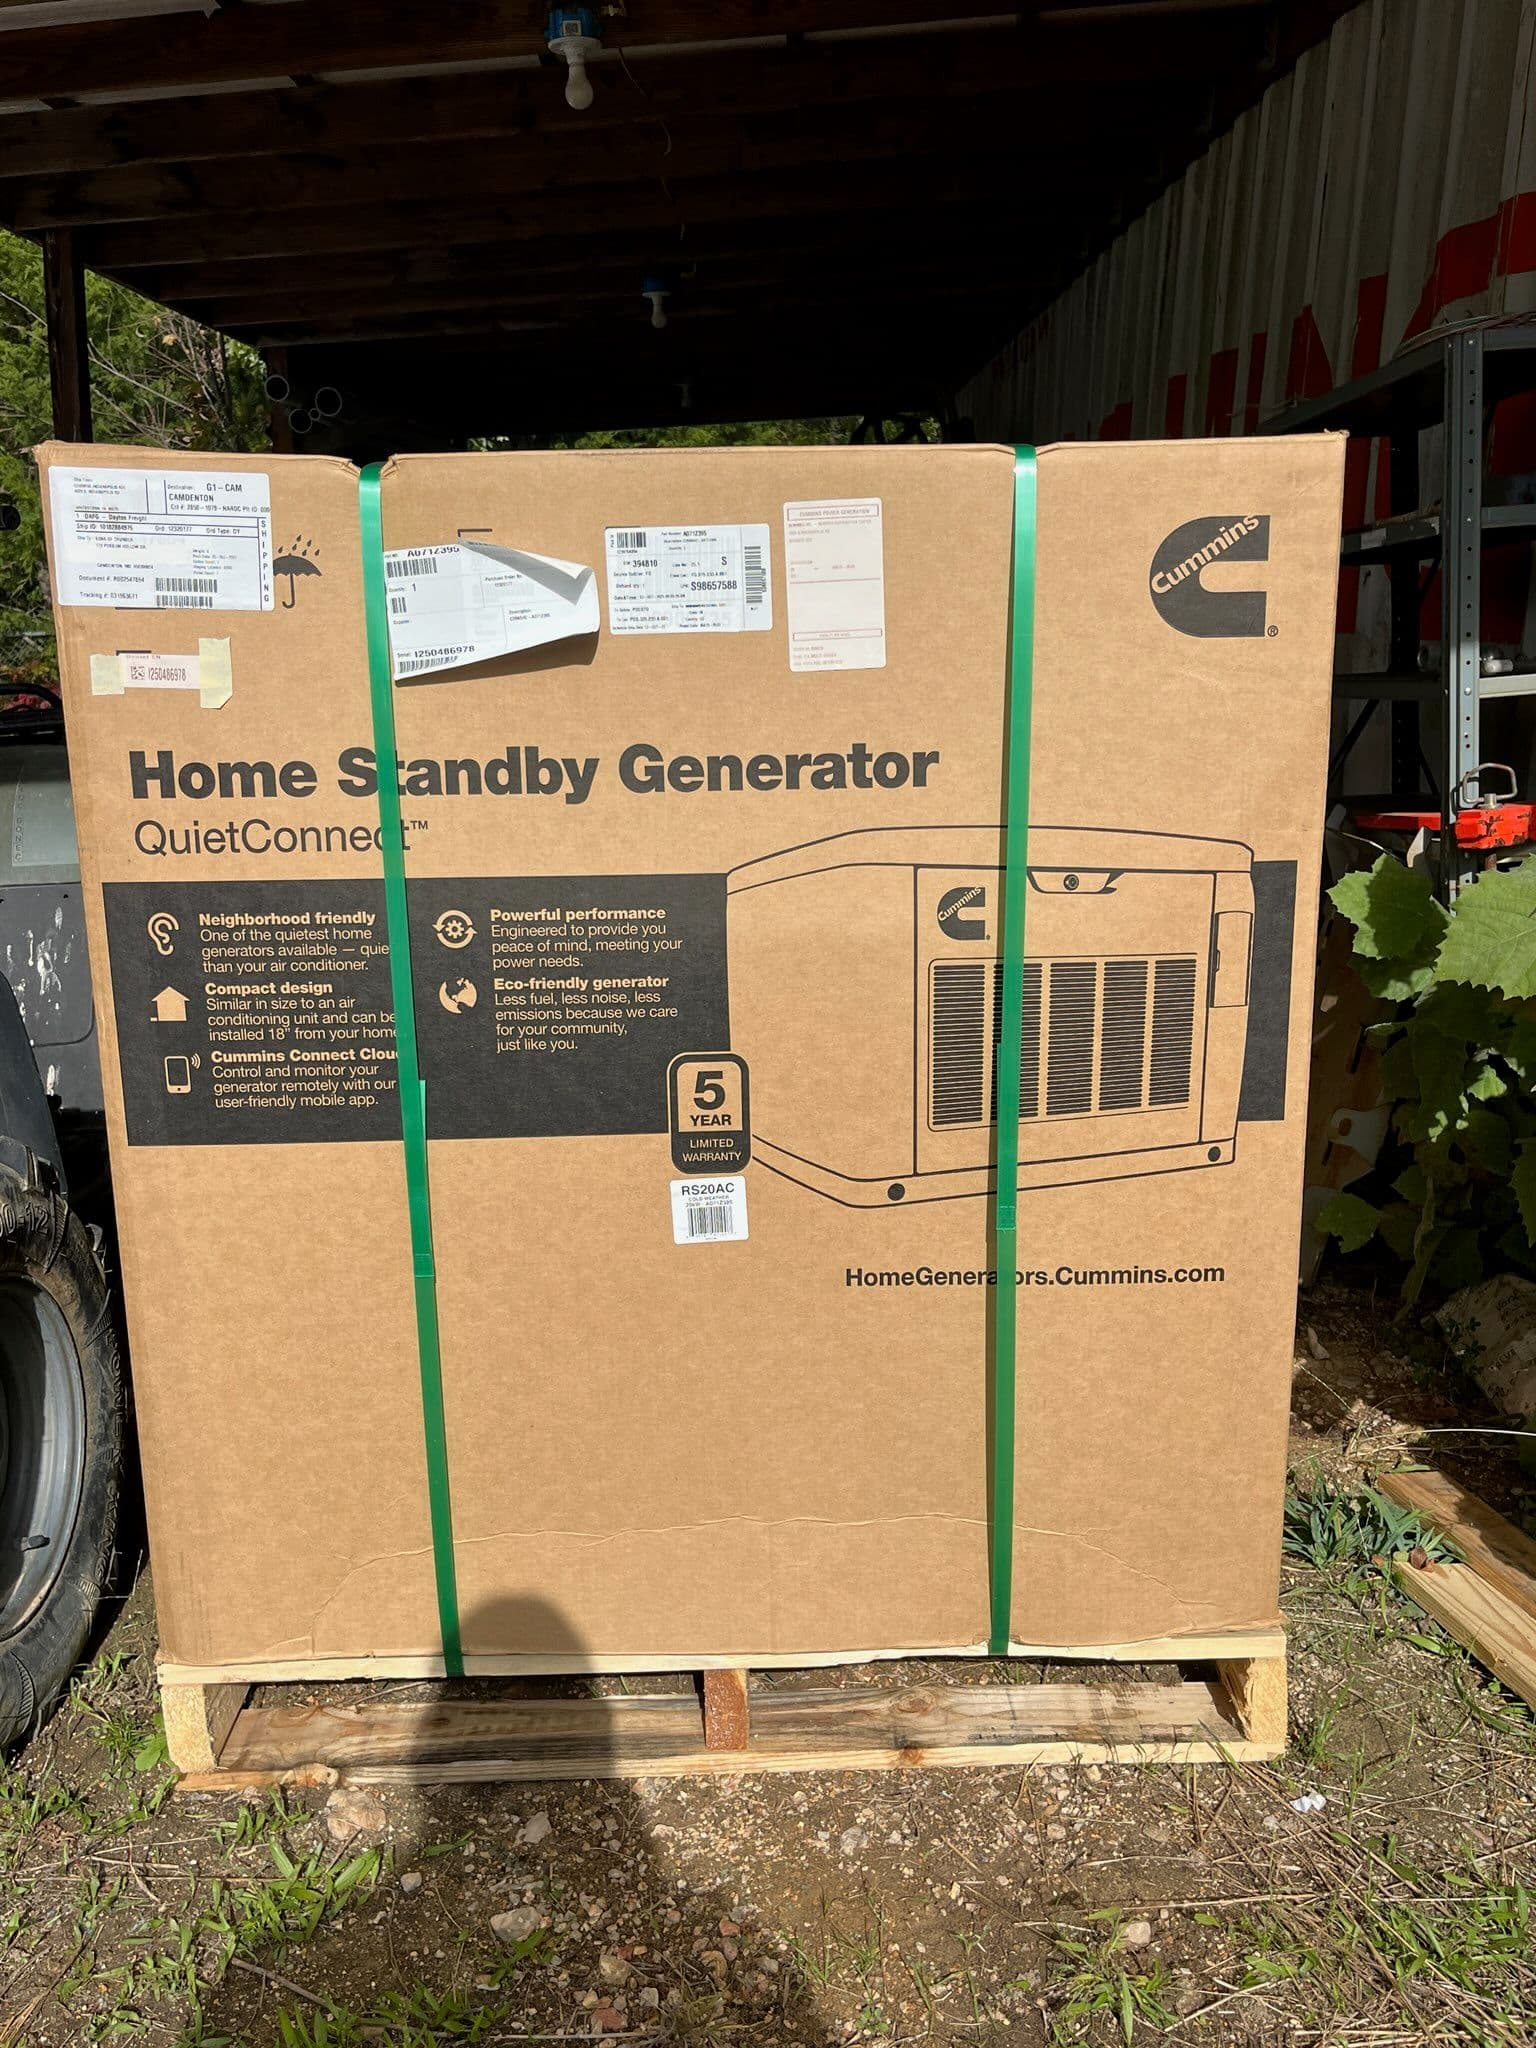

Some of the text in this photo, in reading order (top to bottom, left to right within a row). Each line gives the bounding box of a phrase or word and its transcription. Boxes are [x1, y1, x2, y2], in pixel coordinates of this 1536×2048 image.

[169, 493, 214, 502] CAMDENTON
[721, 556, 727, 566] S
[1151, 515, 1259, 594] Cummins
[632, 560, 657, 568] 394810
[414, 646, 475, 658] 1250486978
[148, 666, 186, 682] 1250486978
[129, 750, 318, 799] Home
[618, 742, 940, 793] Generator
[938, 886, 982, 922] Cummins
[199, 911, 376, 928] Neighborhood friendly
[490, 908, 667, 923] Powerful performance
[200, 927, 372, 944] One of the quietest home
[491, 923, 667, 939] Engineered to provide you
[202, 945, 275, 960] generators
[278, 945, 337, 956] available
[360, 944, 390, 957] quie
[492, 939, 684, 955] peace of mind, meeting your
[203, 959, 368, 975] than your air conditioner.
[493, 956, 584, 971] power needs.
[205, 982, 333, 998] Compact design
[494, 976, 670, 992] Eco-friendly generator
[207, 997, 355, 1010] Similar in size to an air
[495, 991, 661, 1007] Less fuel, less noise, less
[208, 1013, 290, 1028] conditioning
[294, 1013, 318, 1024] unit
[322, 1013, 348, 1024] and
[352, 1014, 376, 1024] can
[496, 1007, 678, 1020] emissions because we care
[209, 1028, 264, 1041] installed
[269, 1028, 290, 1040] 18"
[295, 1027, 325, 1039] from
[330, 1029, 360, 1042] your
[496, 1022, 628, 1038] for your community,
[496, 1037, 579, 1054] just like you.
[210, 1047, 399, 1063] Cummins Connect Clou
[213, 1064, 379, 1079] Control and monitor your
[214, 1079, 396, 1096] generator remotely with our
[693, 1071, 726, 1110] 5
[216, 1094, 379, 1109] user-friendly mobile app.
[690, 1115, 732, 1127] YEAR
[690, 1138, 734, 1149] LIMITED
[683, 1152, 742, 1162] WARRANTY
[681, 1183, 734, 1195] RS20AC
[846, 1265, 1225, 1287] HomeGeneraors.Cummins.com
